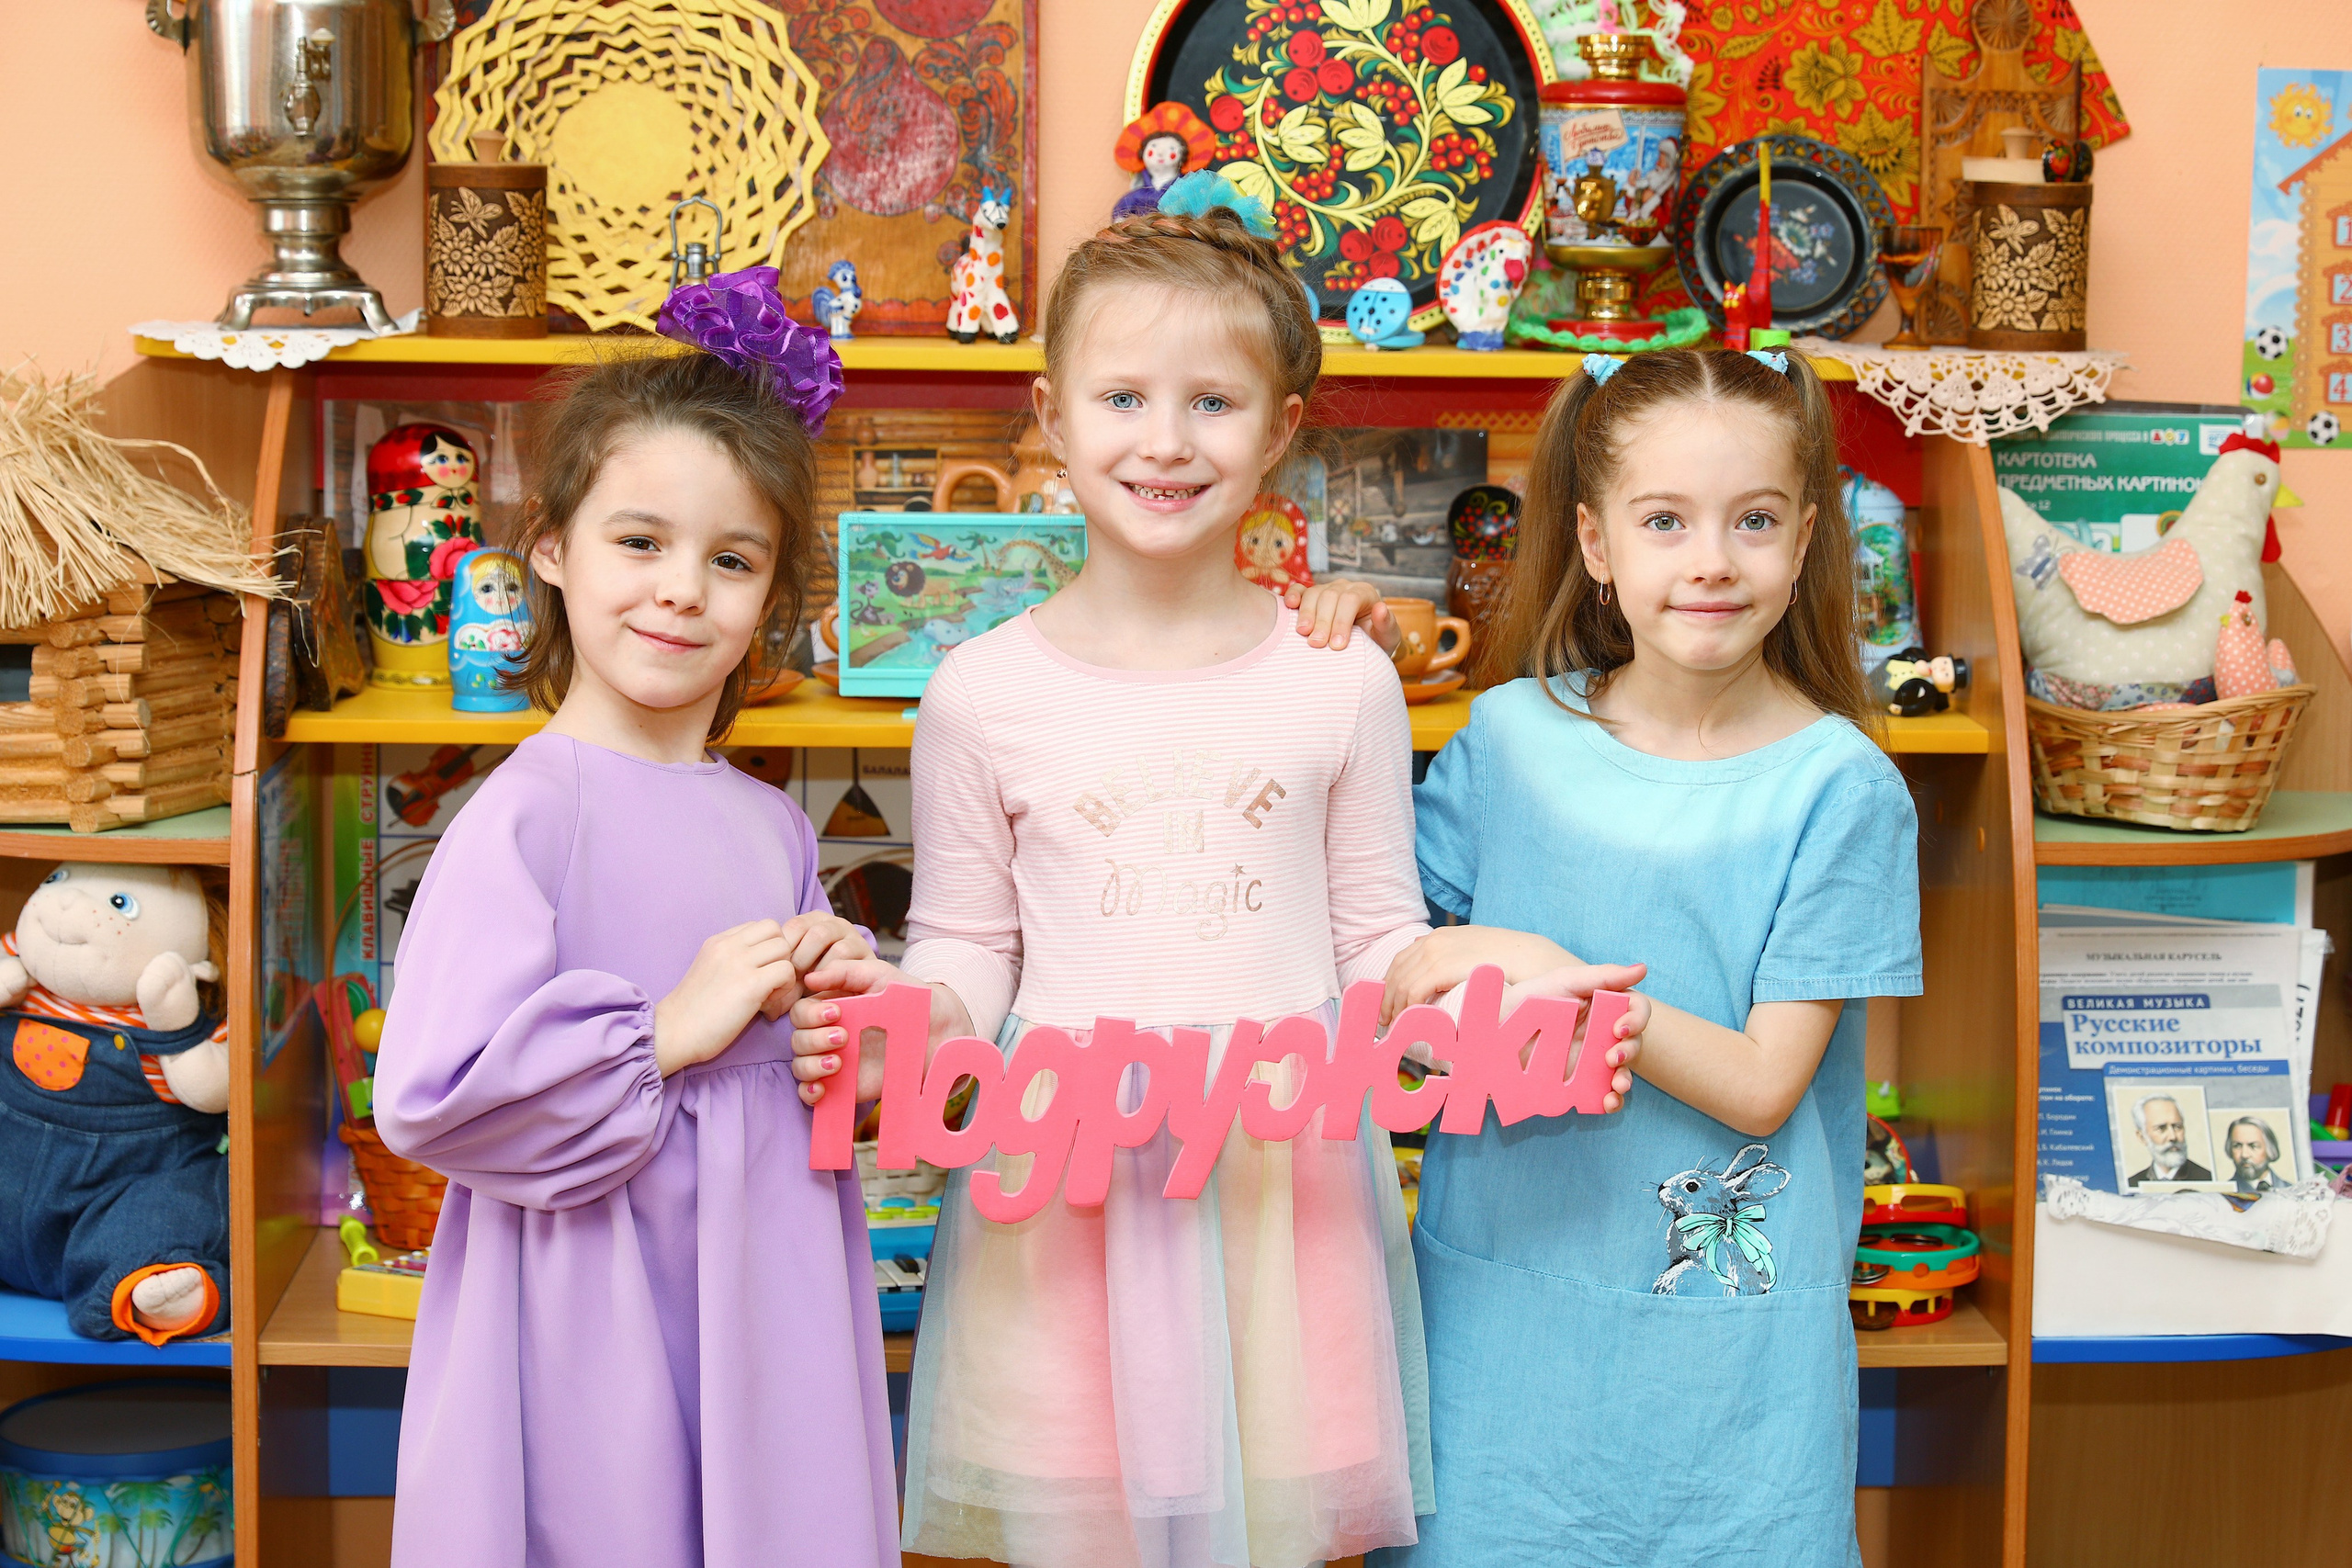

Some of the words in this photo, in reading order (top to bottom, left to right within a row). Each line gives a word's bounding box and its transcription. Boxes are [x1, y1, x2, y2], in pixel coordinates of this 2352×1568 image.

[2339, 277, 2352, 302] 2
[2336, 327, 2350, 351] 3
[2334, 377, 2348, 400] 4
[1996, 452, 2098, 468] КАРТОТЕКА
[1997, 474, 2114, 493] ПРЕДМЕТНЫХ
[863, 765, 910, 775] БАЛАЛА
[360, 744, 375, 824] СТРУНН
[1073, 747, 1286, 838] BELIEVE
[1162, 809, 1204, 854] IN
[1100, 858, 1262, 941] Magic
[2086, 952, 2165, 962] МУЗЫКАЛЬНАЯ
[2167, 952, 2222, 962] КАРУСЕЛЬ
[2067, 998, 2135, 1010] ВЕЛИКАЯ
[2143, 997, 2206, 1009] МУЗЫКА
[2071, 1013, 2181, 1036] Русские
[2075, 1038, 2263, 1058] композиторы
[2109, 1065, 2193, 1076] Демонстрационные
[2237, 1064, 2269, 1075] беседы
